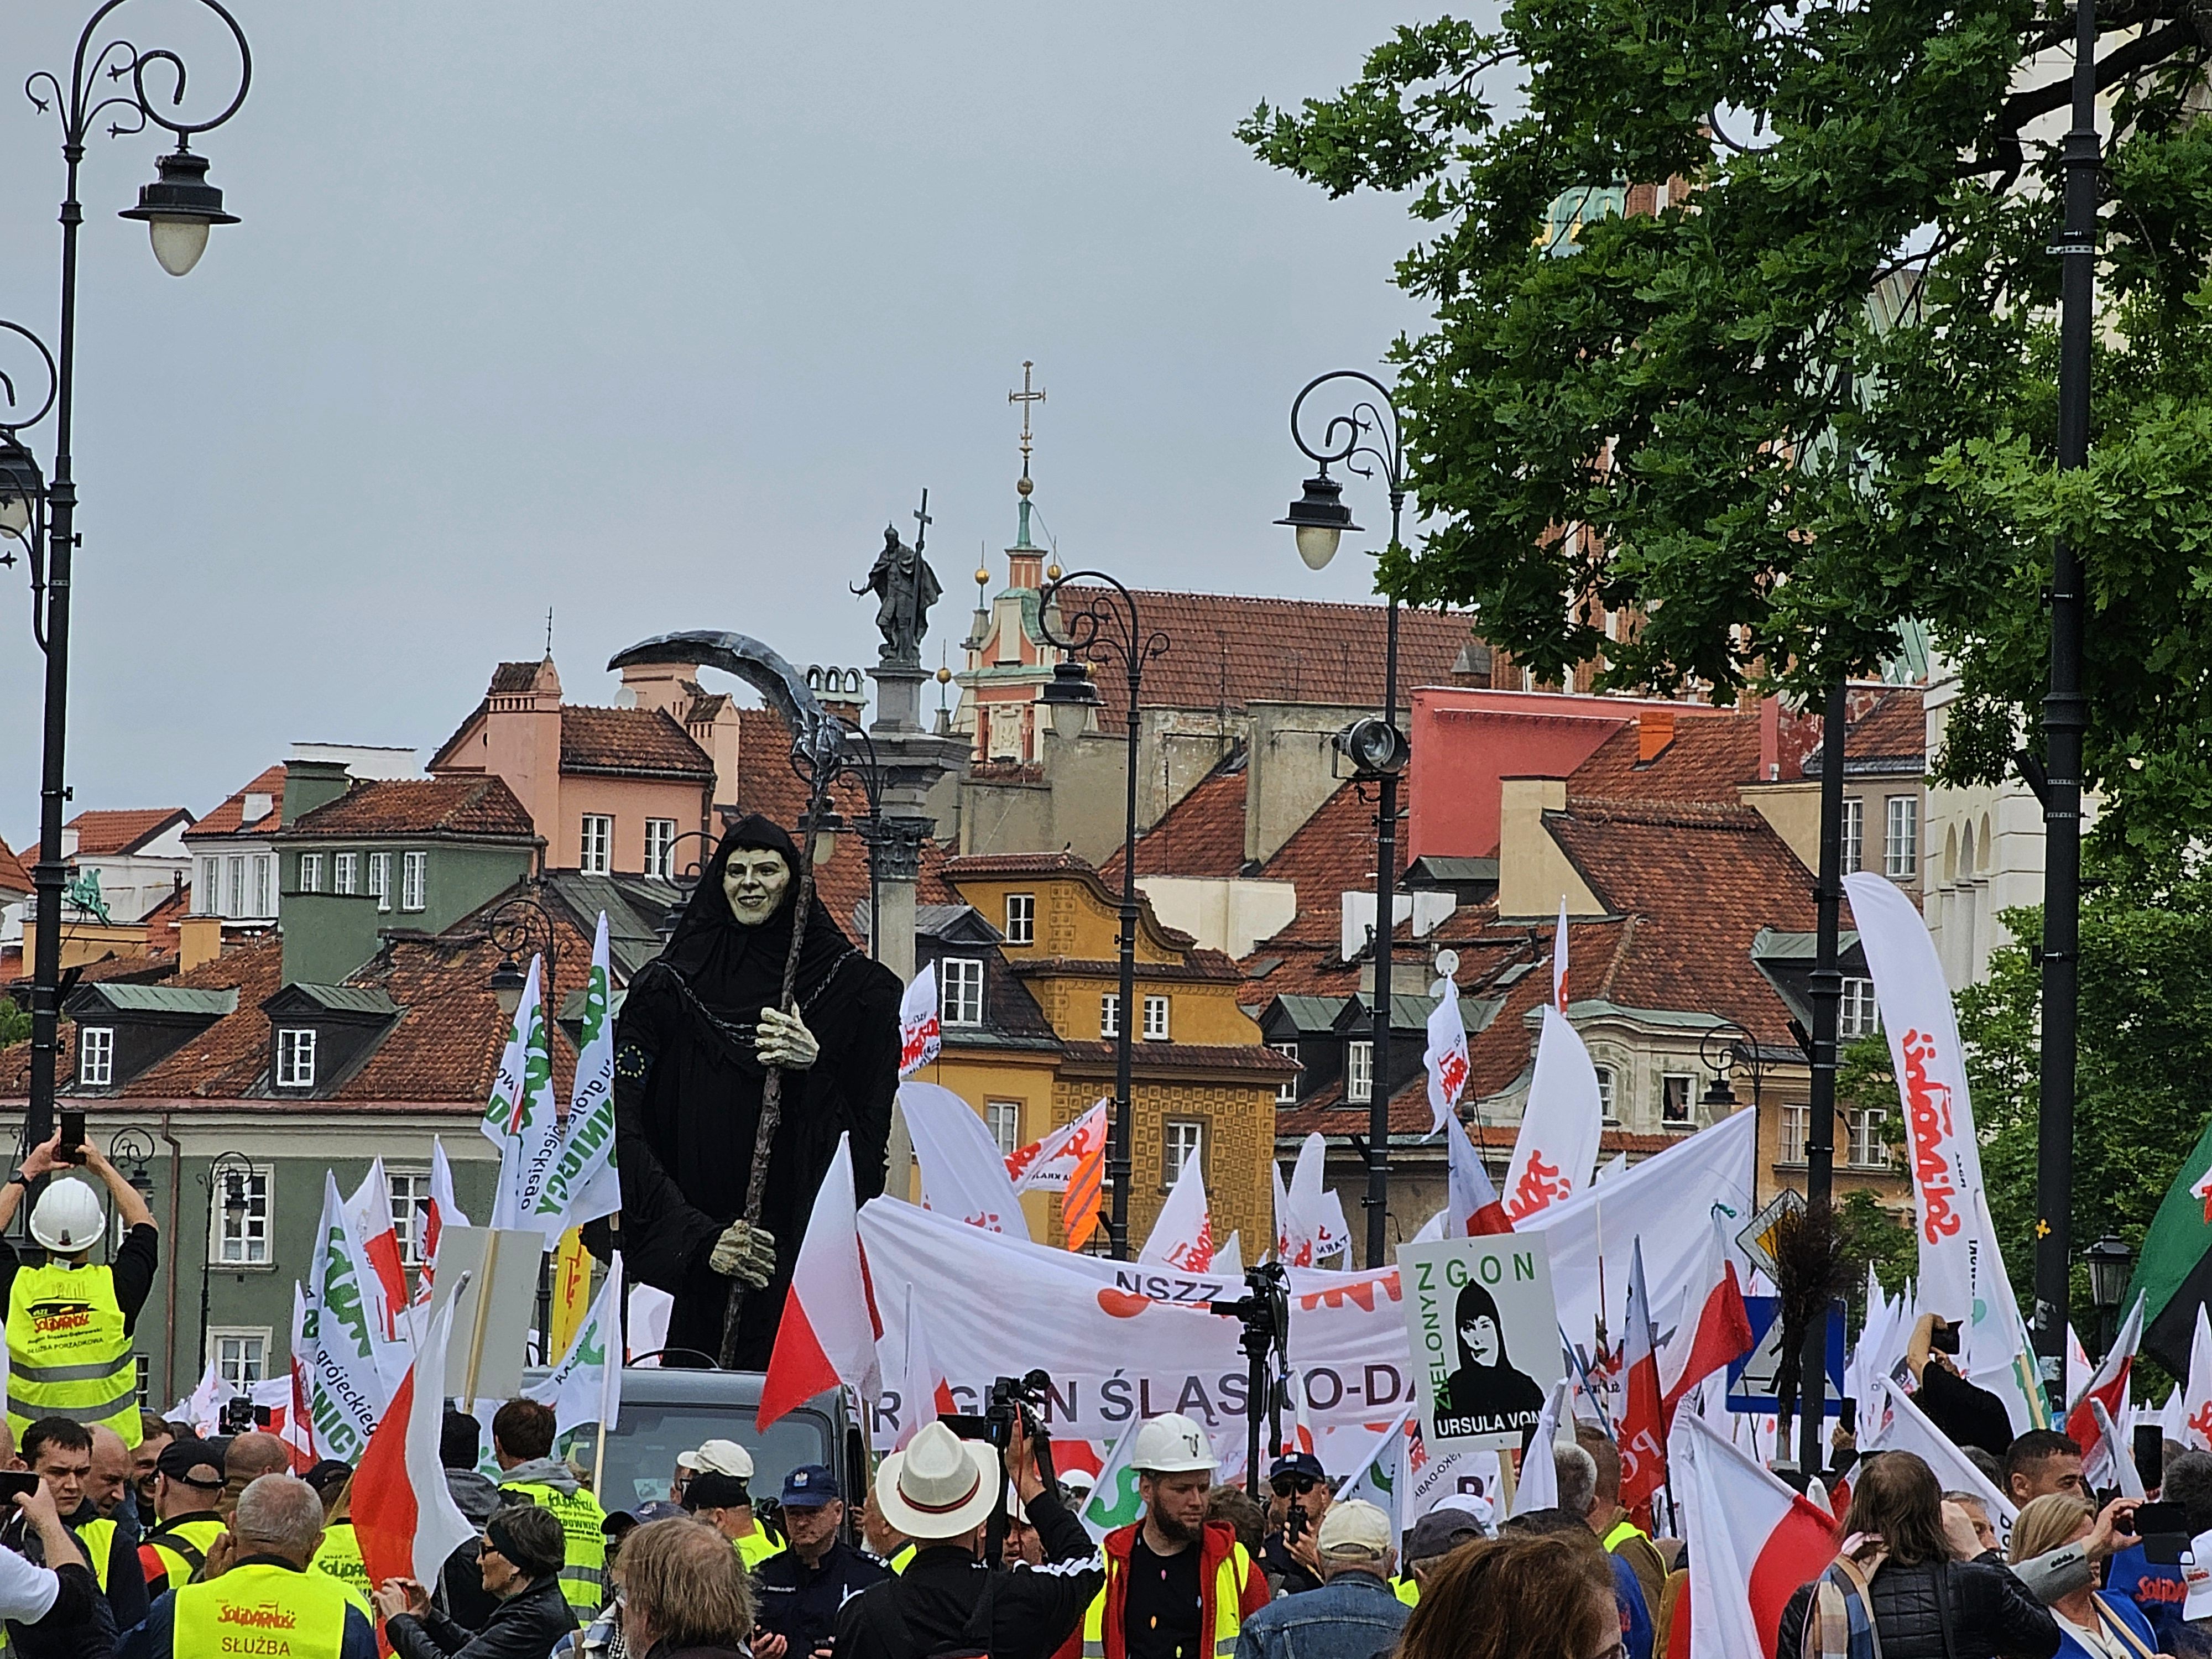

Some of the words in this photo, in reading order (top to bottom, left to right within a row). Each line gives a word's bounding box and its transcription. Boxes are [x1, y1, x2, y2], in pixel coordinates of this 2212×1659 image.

[1117, 1271, 1223, 1302] NSZZ
[1415, 1252, 1535, 1291] ZGON
[1420, 1295, 1452, 1411] ZIELONY
[316, 1349, 378, 1437] grójeckieg
[1437, 1413, 1505, 1436] URSULA
[1507, 1410, 1542, 1429] VON
[222, 1636, 290, 1656] SŁUŻBA
